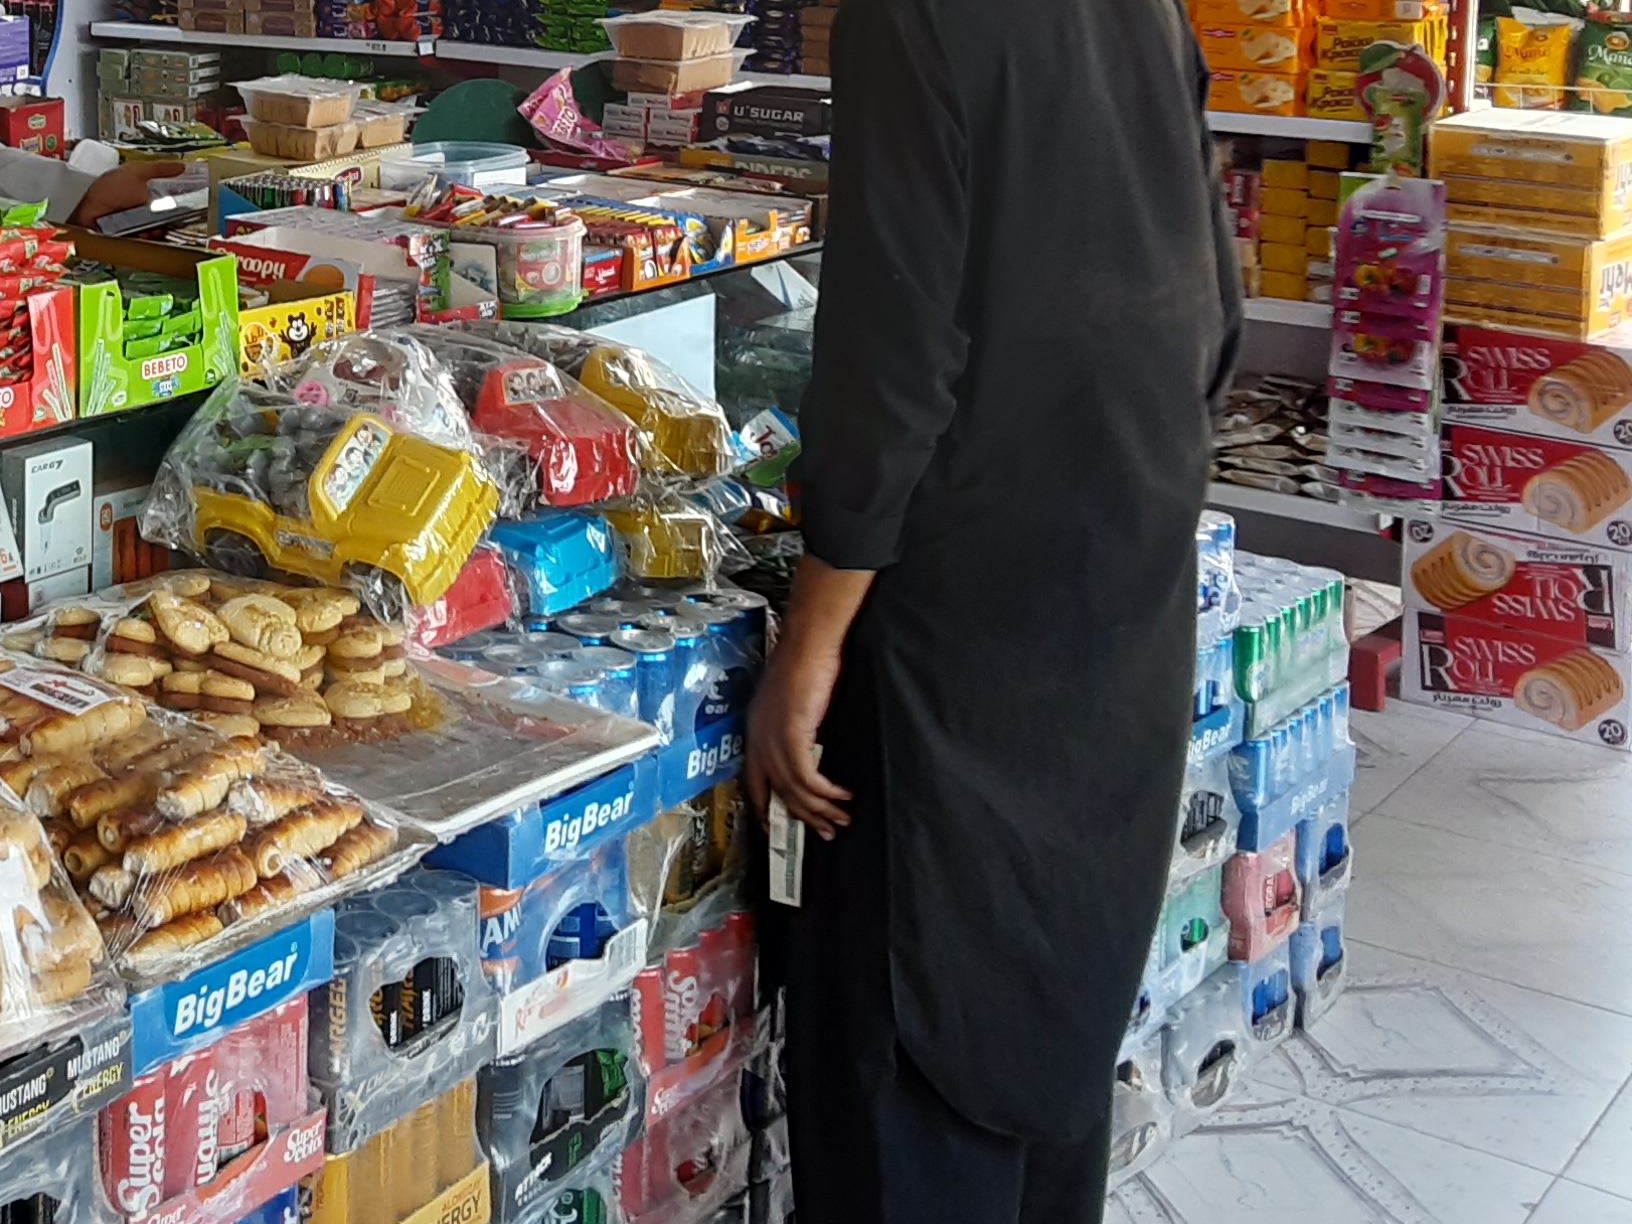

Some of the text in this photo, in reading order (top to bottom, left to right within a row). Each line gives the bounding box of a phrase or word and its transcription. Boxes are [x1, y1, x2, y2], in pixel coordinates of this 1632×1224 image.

[144, 356, 186, 377] BEBETO
[1469, 347, 1551, 370] SWISS
[1461, 444, 1545, 469] SWISS
[1491, 592, 1577, 623] SWISS
[1454, 636, 1536, 665] SWISS
[1186, 724, 1231, 759] igBear
[1600, 722, 1624, 740] 20
[687, 733, 743, 780] BigBe
[544, 789, 635, 854] BigBear
[174, 950, 299, 1037] BigBear
[67, 1035, 121, 1081] MUSTANG
[284, 1120, 323, 1162] Super
[117, 1101, 152, 1220] Super
